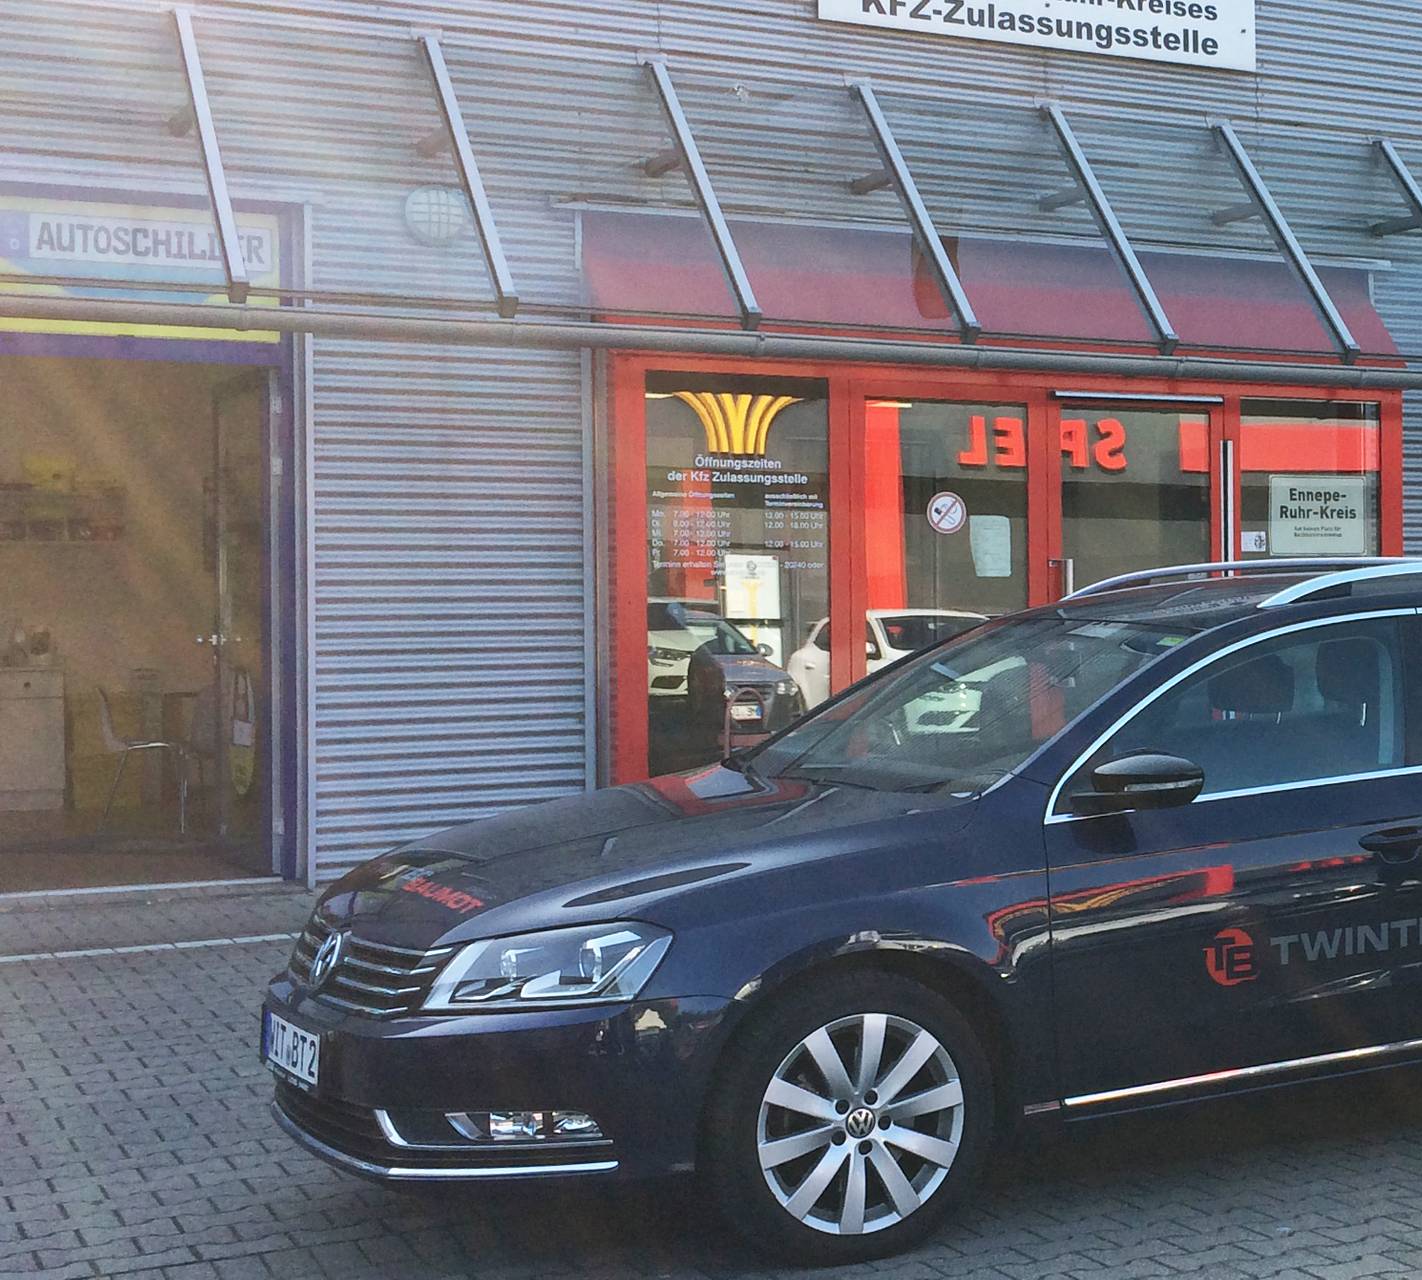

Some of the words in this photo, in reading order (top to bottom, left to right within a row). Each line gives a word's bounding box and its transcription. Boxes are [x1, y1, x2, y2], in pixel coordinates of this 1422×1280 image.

[36, 221, 265, 264] AUTOSCHILDR
[695, 454, 782, 470] Öffnungszeiten
[667, 471, 687, 481] der
[690, 471, 710, 481] Kfz
[712, 472, 808, 485] Zulassungsstelle
[1288, 488, 1347, 504] Ennepe-
[1279, 505, 1357, 520] Ruhr-Kreis
[402, 876, 485, 914] BAUMOT
